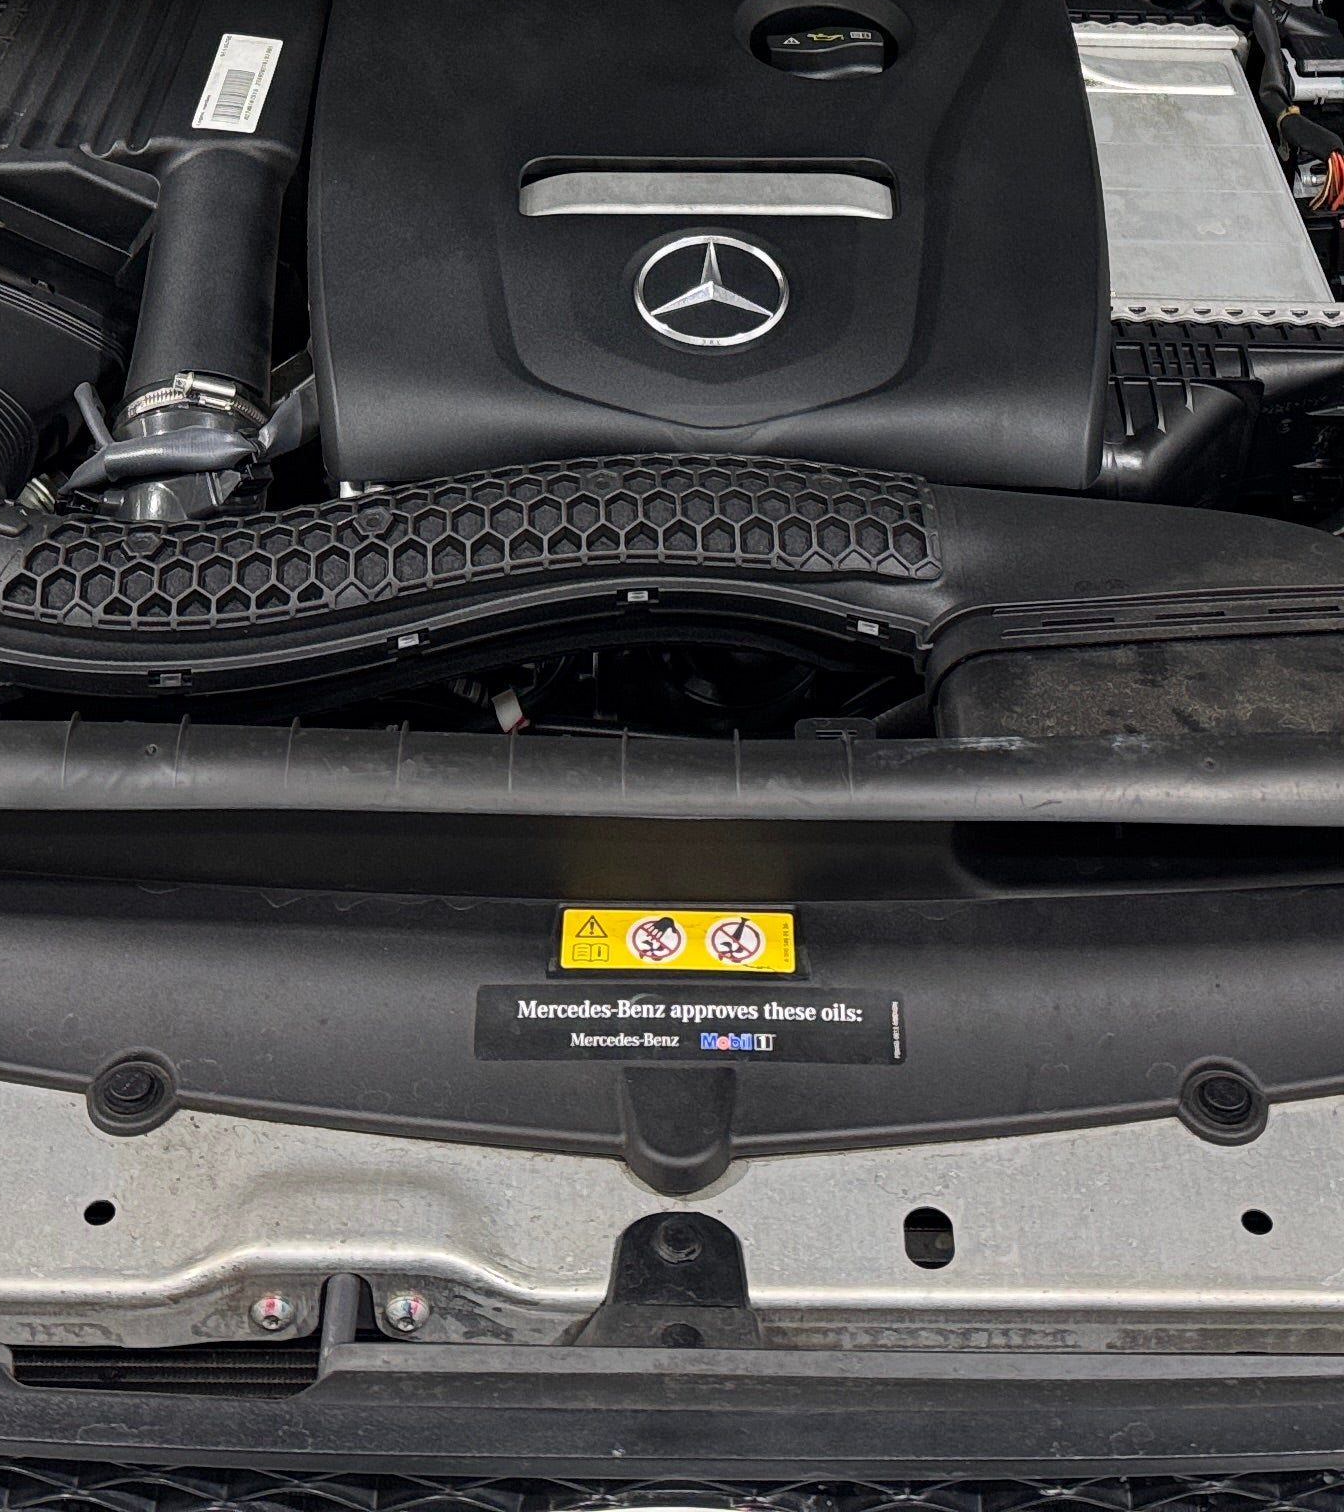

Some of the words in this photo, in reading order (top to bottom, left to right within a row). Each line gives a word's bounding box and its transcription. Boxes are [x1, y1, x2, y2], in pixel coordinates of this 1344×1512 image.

[516, 999, 666, 1019] Mercedes-Benz
[669, 1003, 759, 1023] approves
[763, 1001, 817, 1021] these
[821, 1003, 863, 1022] oils:
[569, 1032, 680, 1048] Mercedes-Benz
[700, 1033, 753, 1051] Mobil
